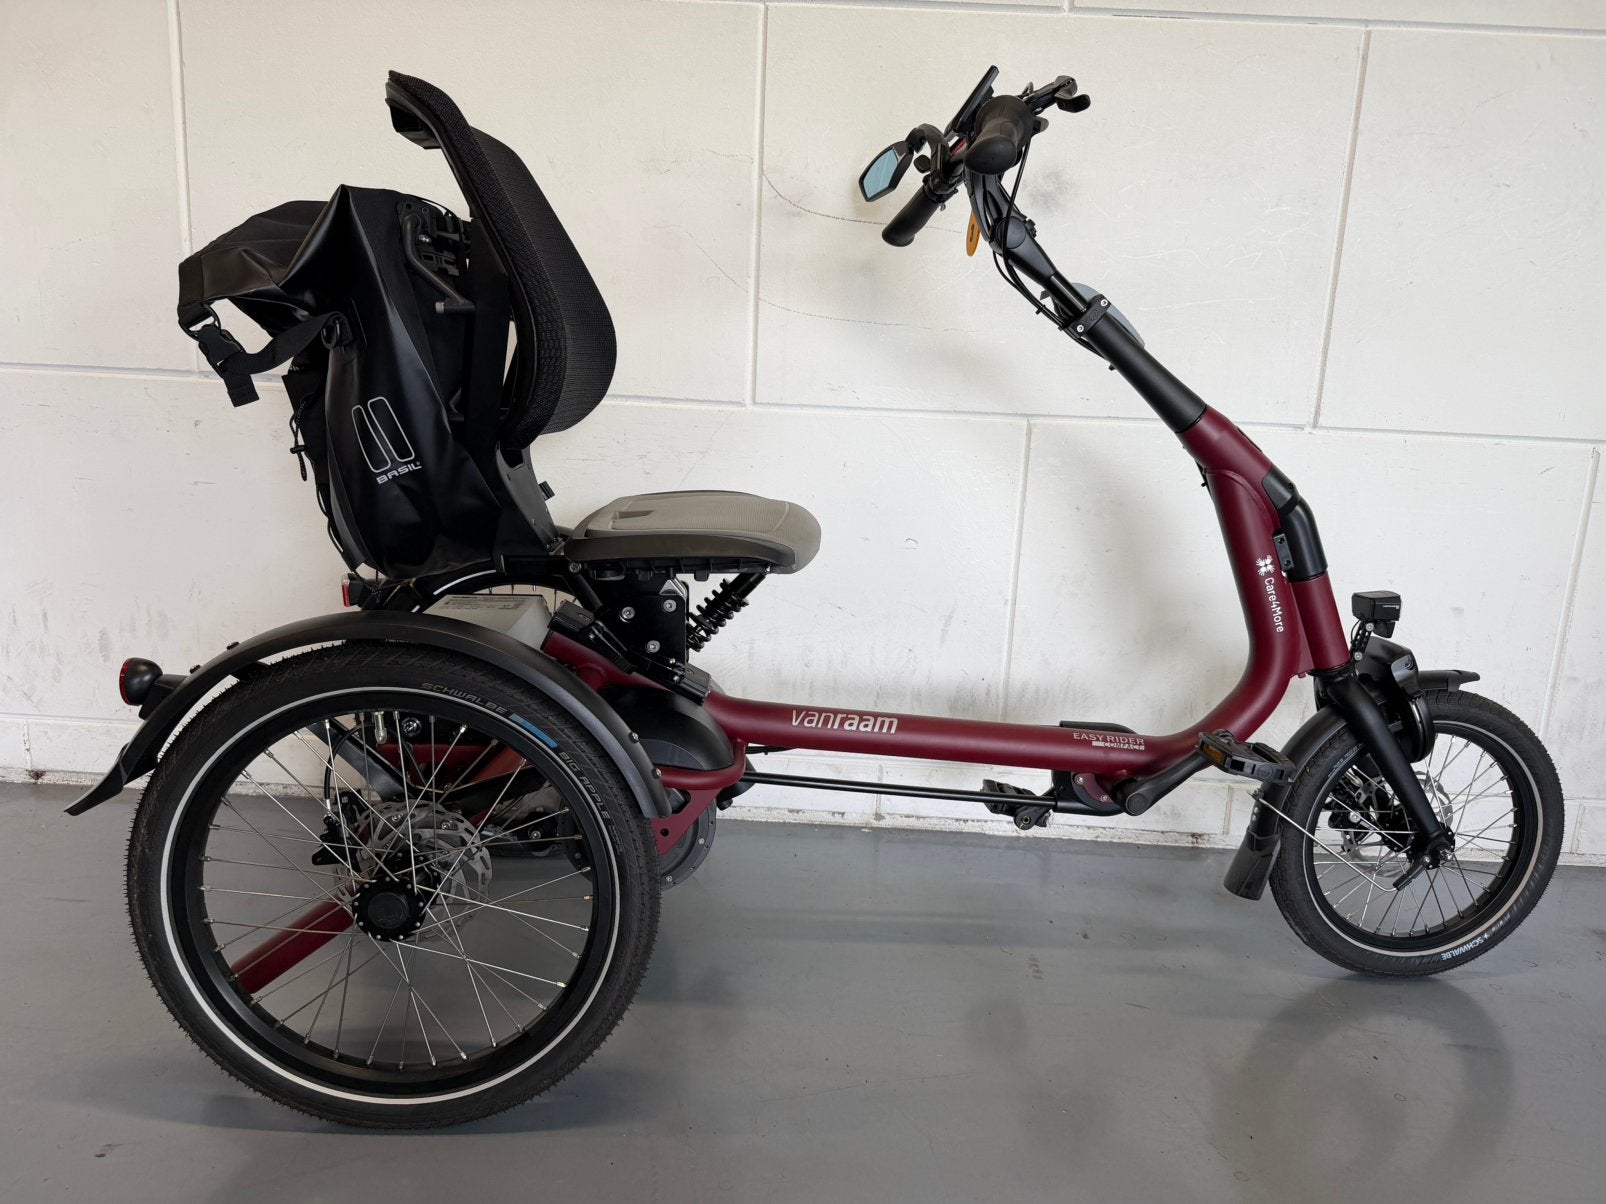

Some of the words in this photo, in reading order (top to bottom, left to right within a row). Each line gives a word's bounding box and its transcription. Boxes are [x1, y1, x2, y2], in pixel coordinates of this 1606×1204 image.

[1264, 577, 1284, 633] Care4More
[421, 682, 508, 714] SCHWALBE
[791, 710, 898, 734] vanraam
[1073, 732, 1104, 742] EASY
[1106, 735, 1145, 745] RIDER
[559, 752, 580, 772] BIG
[580, 776, 611, 820] APPLE
[1441, 936, 1484, 961] SCHWALBE
